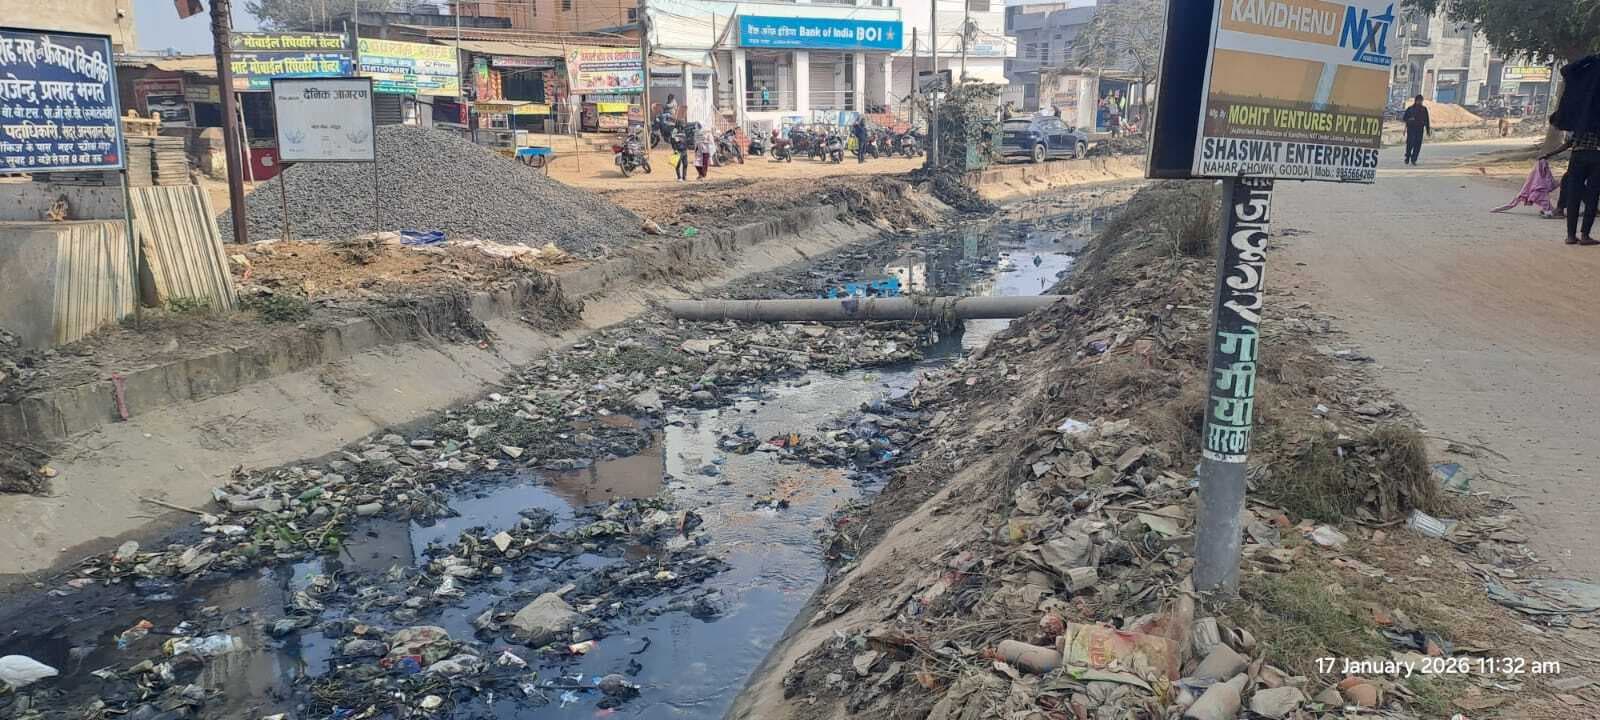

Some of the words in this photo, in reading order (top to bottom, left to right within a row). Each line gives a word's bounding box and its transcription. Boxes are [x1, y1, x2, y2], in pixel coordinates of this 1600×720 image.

[1231, 0, 1337, 36] KAMDHENU
[800, 26, 821, 37] Bank
[822, 27, 832, 37] of
[833, 28, 853, 39] India
[856, 27, 882, 41] BOI
[303, 87, 331, 100] दैनिक
[334, 89, 368, 100] जागरण
[1228, 105, 1270, 127] MOHIT
[1273, 108, 1333, 132] VENTURES
[1335, 116, 1358, 134] PVT.
[1359, 118, 1382, 137] LTD.
[1203, 137, 1282, 163] SHASWAT
[1286, 143, 1379, 169] ENTERPRISES
[1203, 161, 1238, 174] NAHAR
[1279, 165, 1309, 178] GODDA
